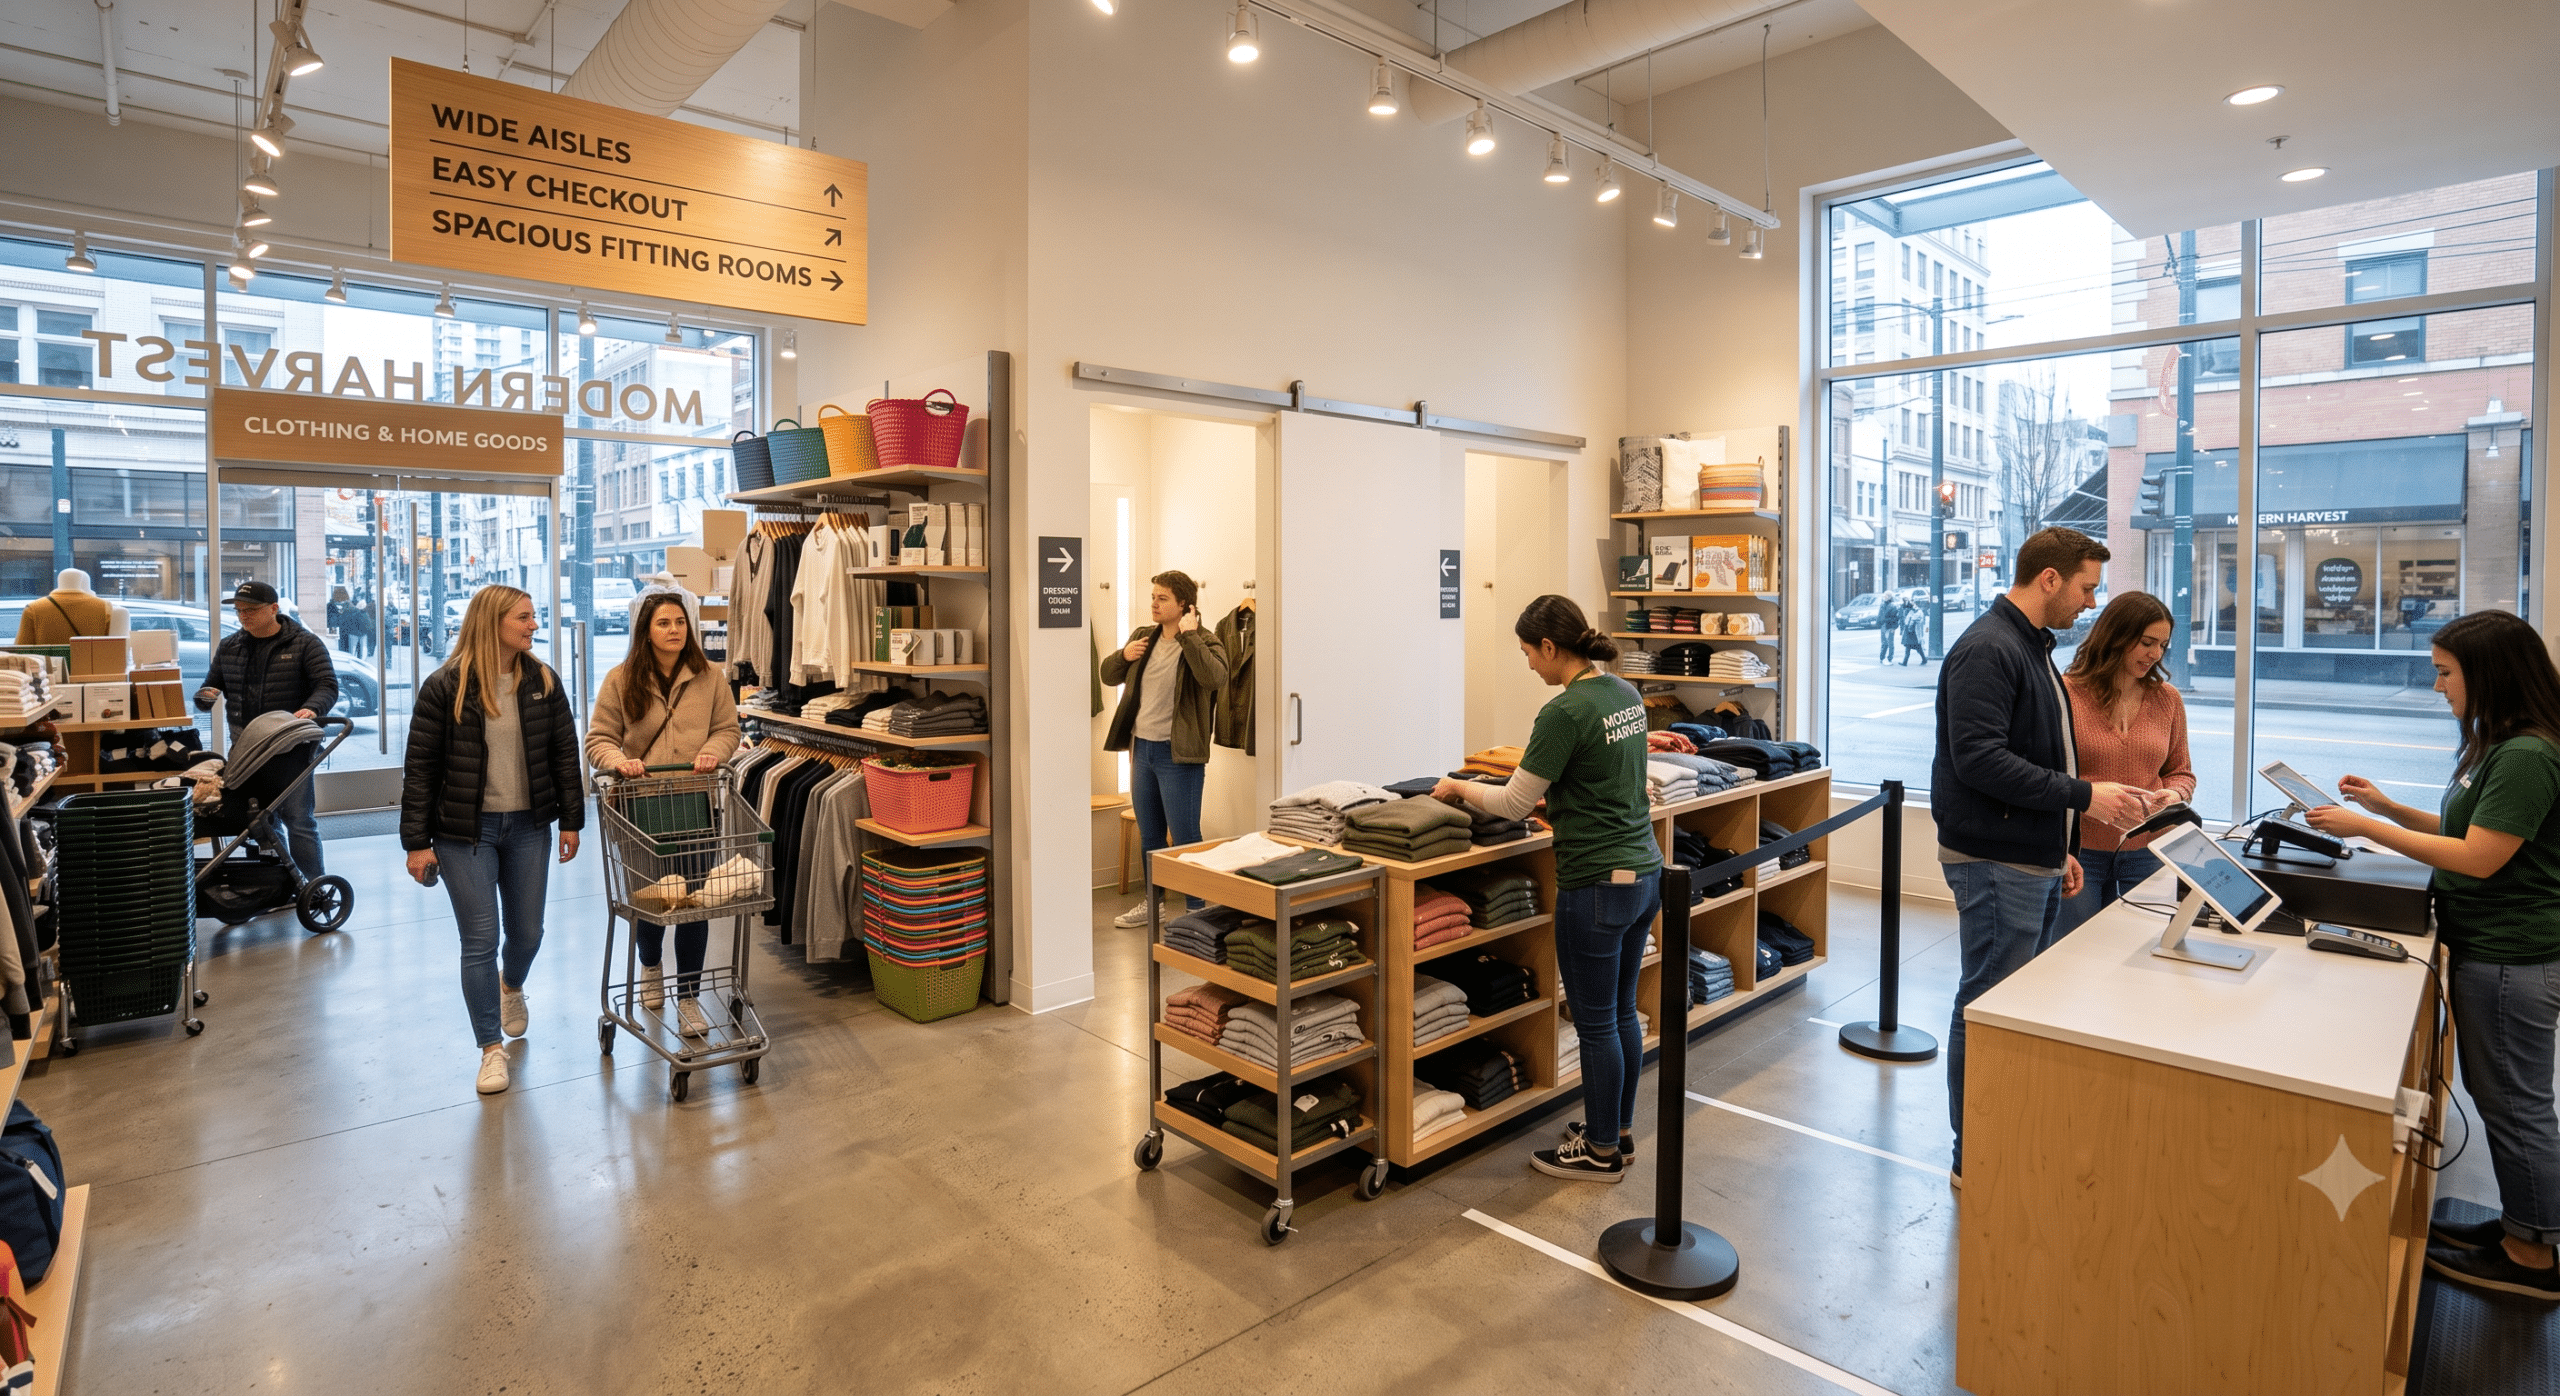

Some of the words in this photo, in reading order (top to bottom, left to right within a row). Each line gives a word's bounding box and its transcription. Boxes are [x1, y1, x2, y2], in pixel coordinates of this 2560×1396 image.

[431, 103, 519, 143] WIDE
[527, 125, 631, 164] AISLES
[433, 156, 517, 192] EASY
[526, 174, 688, 221] CHECKOUT
[432, 209, 592, 254] SPACIOUS
[601, 235, 710, 272] FITTING
[718, 253, 812, 287] ROOMS
[244, 416, 370, 441] CLOTHING
[378, 426, 394, 442] &
[401, 427, 468, 447] HOME
[473, 432, 548, 452] GOODS
[2227, 512, 2284, 525] MERN
[2287, 510, 2349, 523] HARVEST
[1043, 587, 1078, 595] DRESSING
